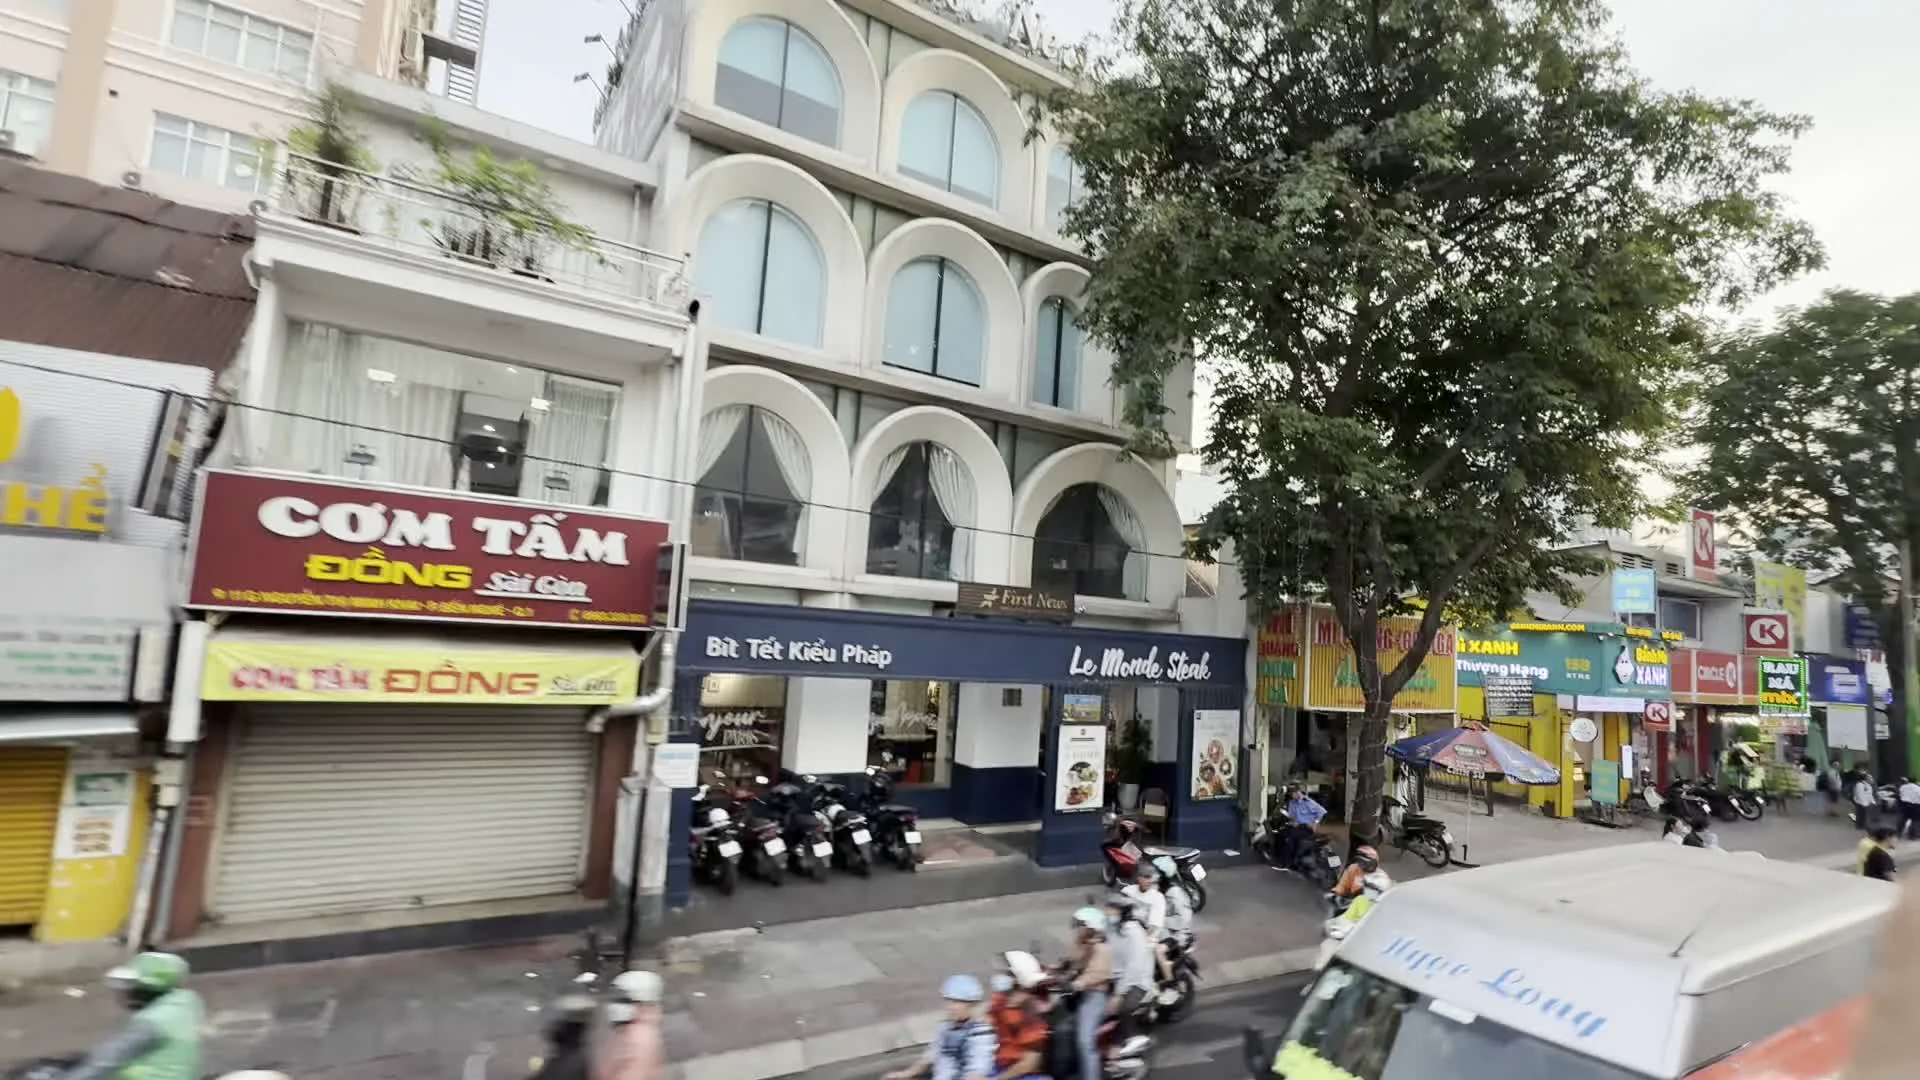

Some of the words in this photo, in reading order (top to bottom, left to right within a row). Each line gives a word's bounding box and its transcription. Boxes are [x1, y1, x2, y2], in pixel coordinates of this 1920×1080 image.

[258, 496, 456, 550] CƠM
[472, 512, 630, 566] TẤM
[304, 546, 472, 590] ĐỒNG
[484, 570, 535, 593] Sài
[535, 574, 587, 597] Gòn
[745, 636, 784, 660] Tết
[842, 644, 892, 669] Pháp
[1070, 645, 1097, 676] Le
[1100, 645, 1163, 679] Monde
[1167, 651, 1211, 681] Steak
[1469, 640, 1519, 656] XANH
[382, 660, 540, 695] ĐỒNG
[1456, 660, 1508, 677] Thượng
[1510, 664, 1549, 680] Hạng
[1636, 665, 1668, 687] XANH
[1762, 661, 1800, 675] RAU
[1768, 676, 1795, 690] MÁ
[1479, 967, 1608, 1037] Long
